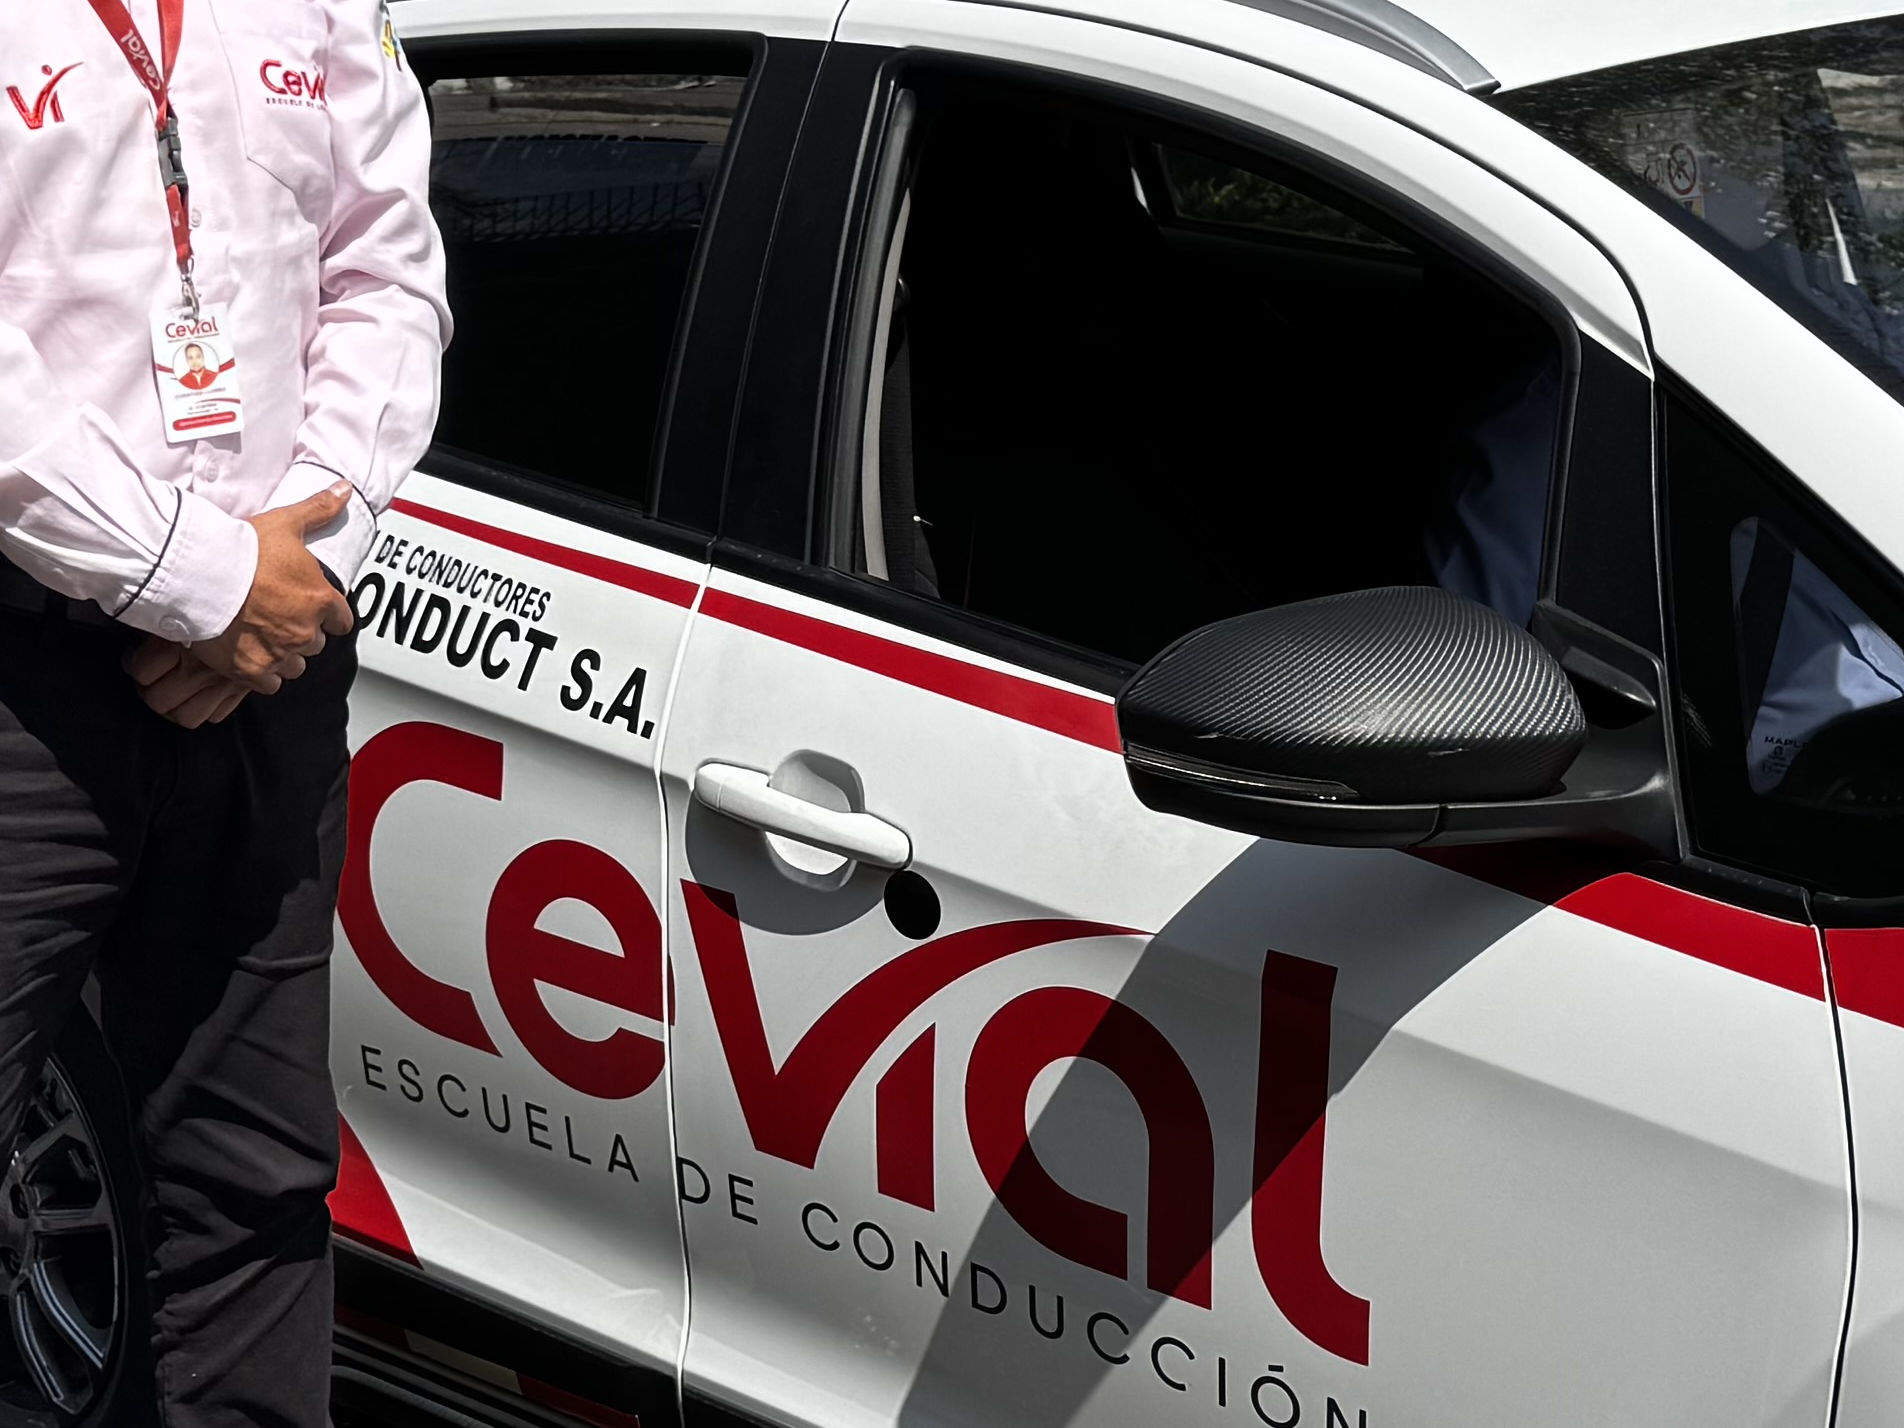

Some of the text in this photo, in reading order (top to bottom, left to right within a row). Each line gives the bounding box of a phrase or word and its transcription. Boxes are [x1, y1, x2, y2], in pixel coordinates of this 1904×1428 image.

[121, 29, 163, 90] Cevial
[165, 316, 219, 338] Cevial
[374, 534, 552, 623] DE CONDUCTORES
[356, 572, 656, 740] ONDUCT S.A.
[336, 720, 1371, 1366] Cevial
[360, 1045, 641, 1182] ESCUELA
[678, 1156, 760, 1226] DE
